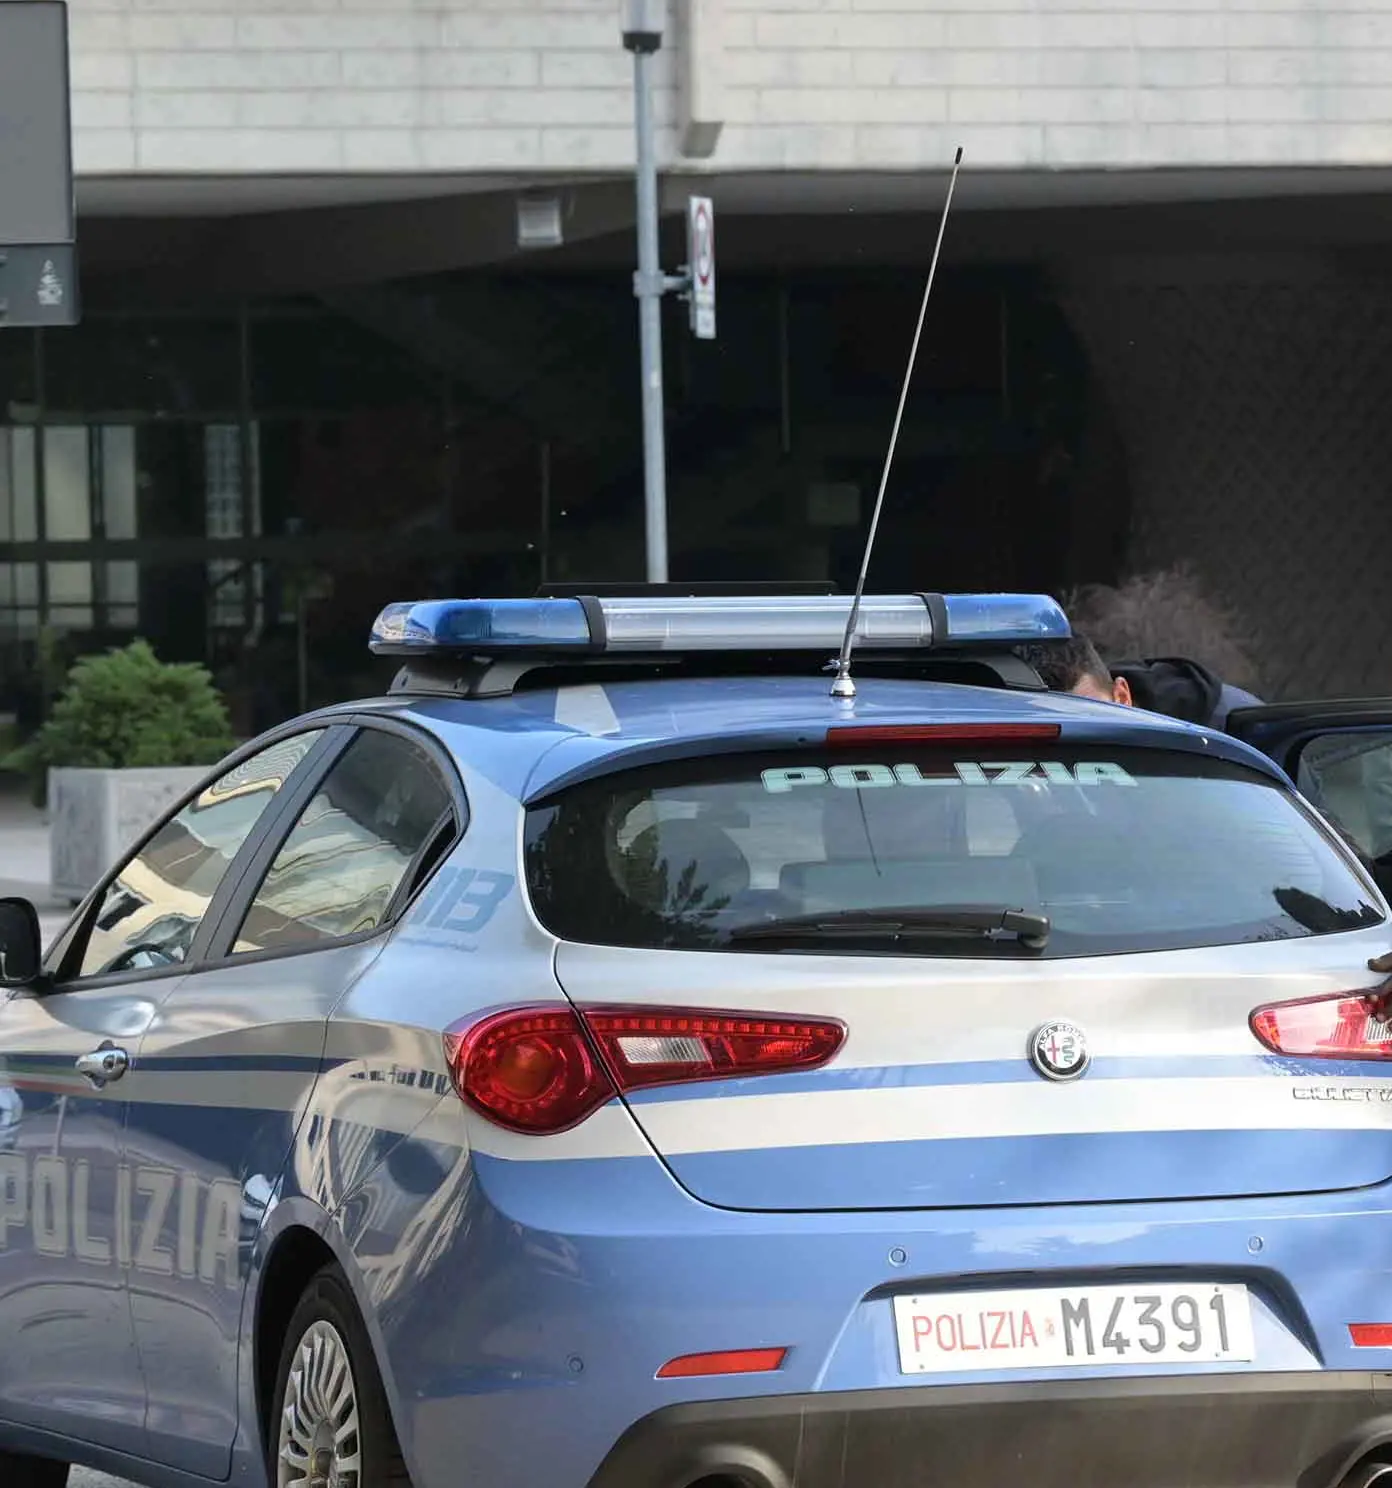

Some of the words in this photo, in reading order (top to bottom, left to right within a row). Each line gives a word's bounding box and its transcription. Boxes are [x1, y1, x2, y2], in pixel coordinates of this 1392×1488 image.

[760, 762, 1138, 793] POLIZIA
[0, 1151, 241, 1291] POLIZIA
[912, 1310, 1039, 1352] POLIZIA
[1060, 1294, 1230, 1357] M4391
